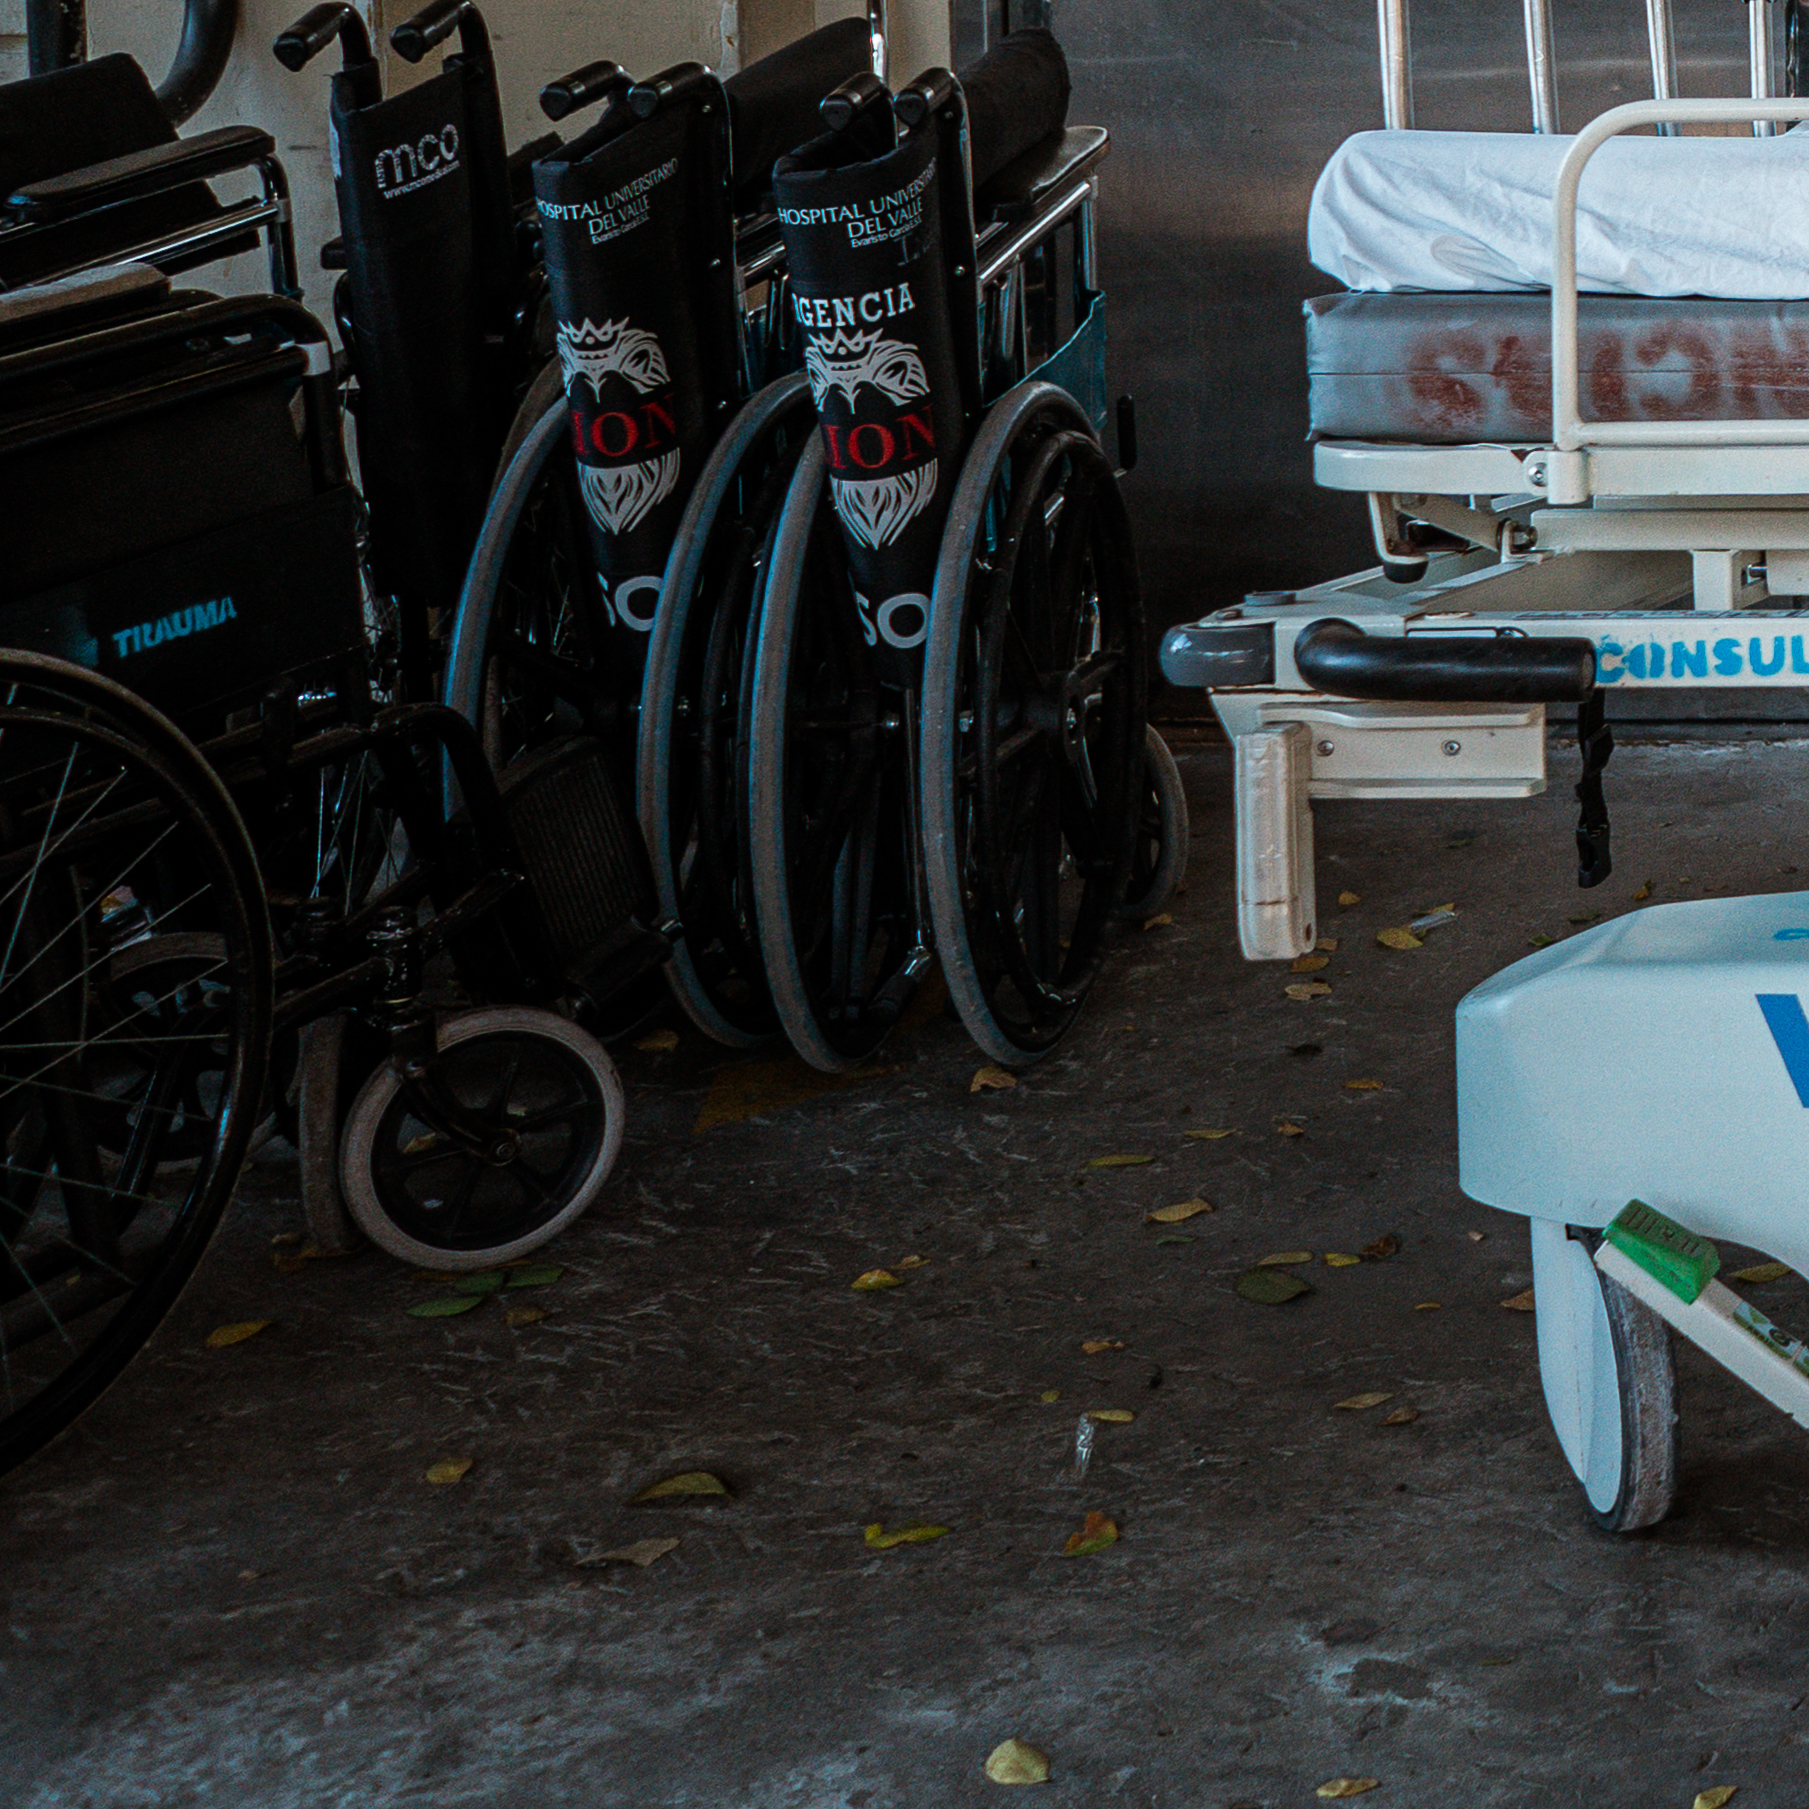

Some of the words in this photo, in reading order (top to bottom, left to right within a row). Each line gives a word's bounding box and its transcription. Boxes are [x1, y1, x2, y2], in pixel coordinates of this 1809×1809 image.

[374, 123, 460, 189] mco
[603, 157, 679, 210] UNIVERSITARIO
[588, 213, 618, 236] DEL
[618, 194, 652, 223] VALLE
[776, 203, 866, 226] HOSPITAL
[846, 215, 888, 239] DEL
[886, 195, 924, 228] VALLE
[112, 594, 238, 660] TRAUMA
